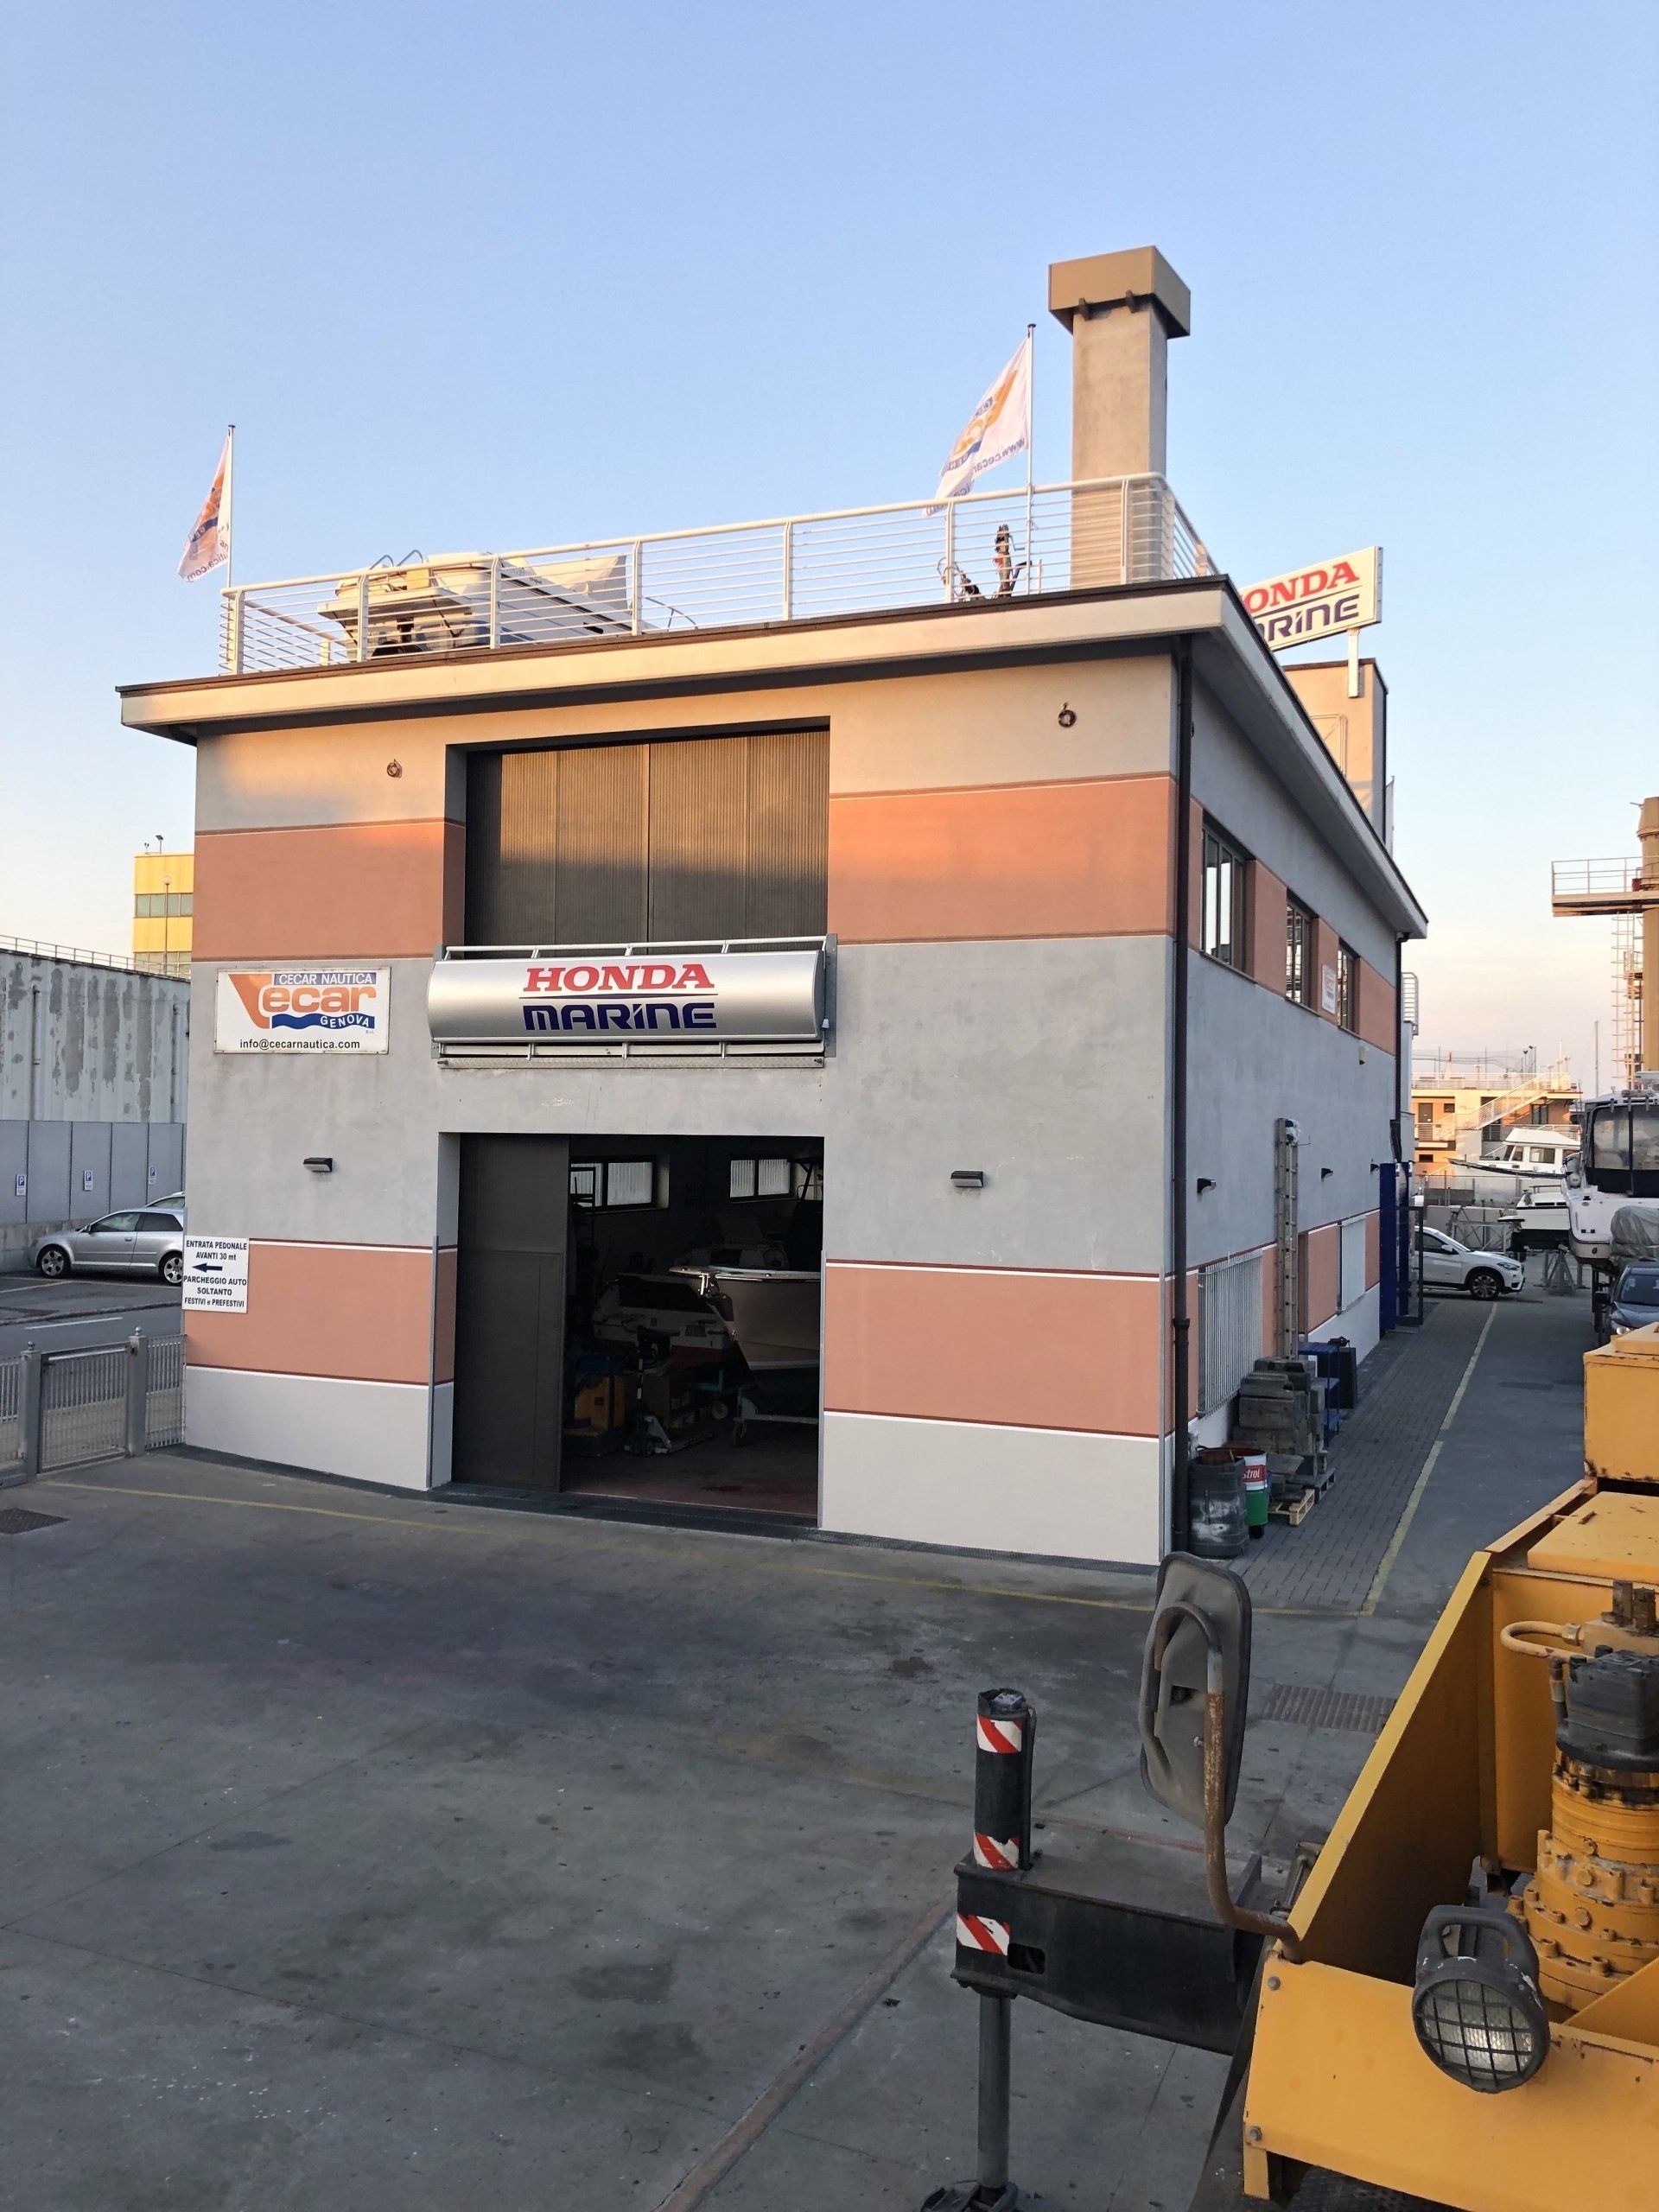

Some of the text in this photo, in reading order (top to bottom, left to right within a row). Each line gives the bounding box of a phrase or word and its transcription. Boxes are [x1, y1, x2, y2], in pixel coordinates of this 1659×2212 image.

[278, 973, 373, 985] CECAR NAUTICA
[523, 963, 715, 992] HONDA
[320, 1014, 369, 1028] GENOVA
[523, 1002, 717, 1031] MARINE
[239, 1039, 360, 1051] info@cecarnautica.com
[186, 1240, 247, 1250] ENTRATA PEDONALE
[183, 1275, 226, 1284] PARCHEGGIO
[197, 1287, 232, 1296] SOLTANTO
[184, 1297, 206, 1306] FESTIVI
[212, 1299, 245, 1307] PREFESTIVI
